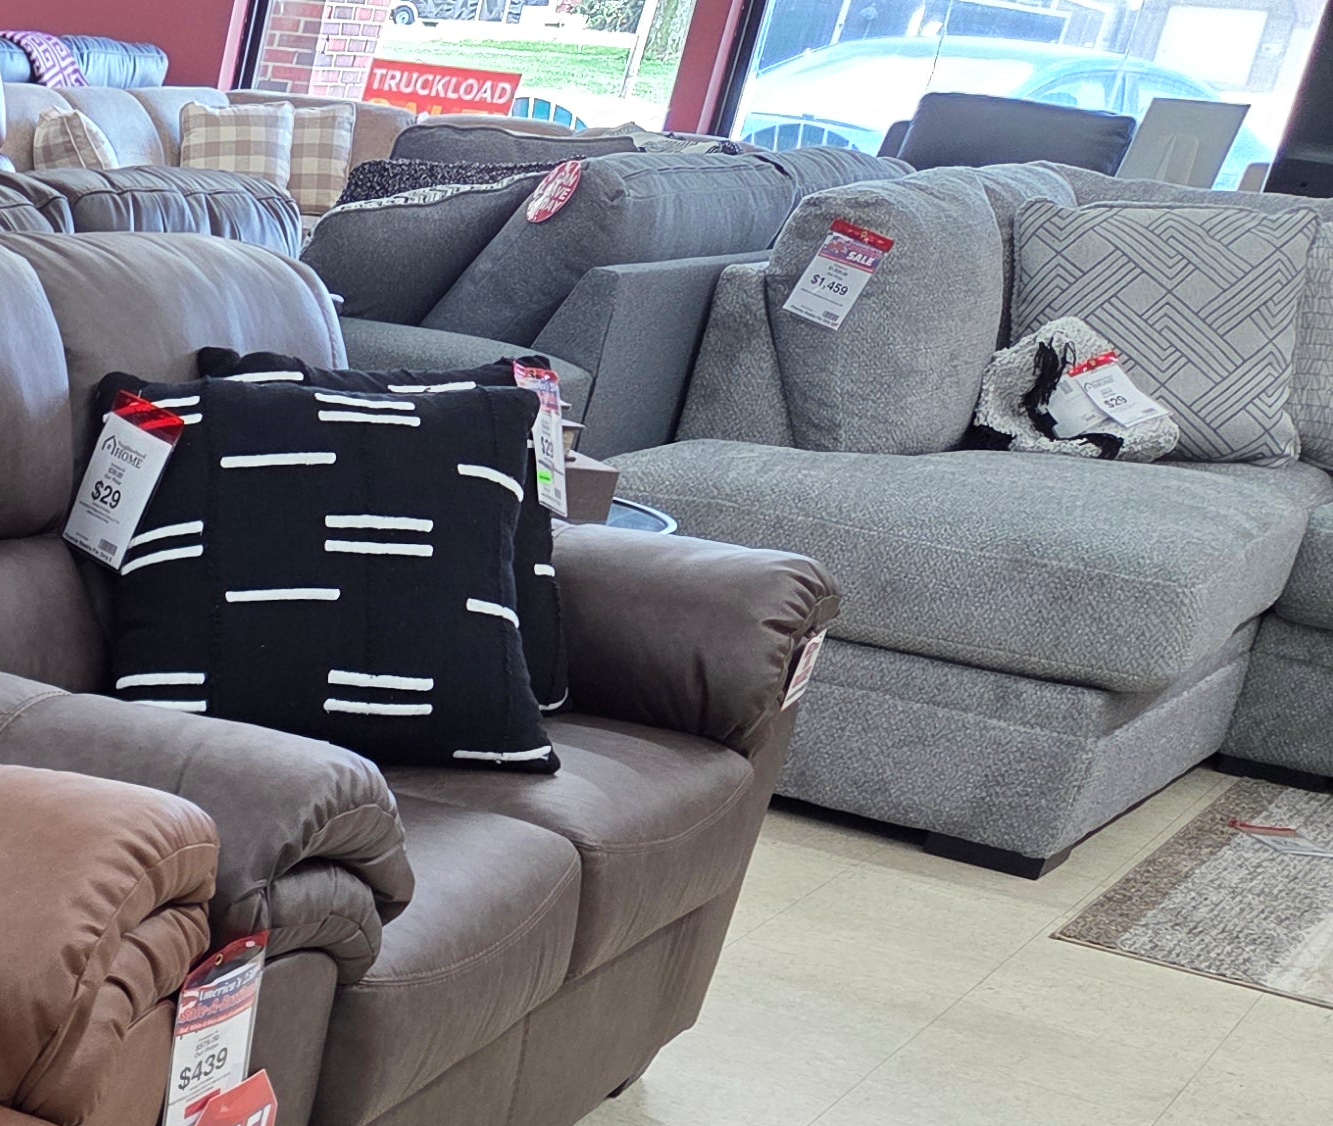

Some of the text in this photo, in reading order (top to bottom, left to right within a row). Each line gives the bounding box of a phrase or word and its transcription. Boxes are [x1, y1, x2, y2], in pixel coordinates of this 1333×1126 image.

[372, 68, 513, 105] TRUCKLOAD
[846, 251, 875, 266] SALE
[810, 274, 848, 296] $1,459
[116, 447, 144, 469] HOME
[91, 480, 122, 509] $29
[179, 1047, 229, 1092] $439
